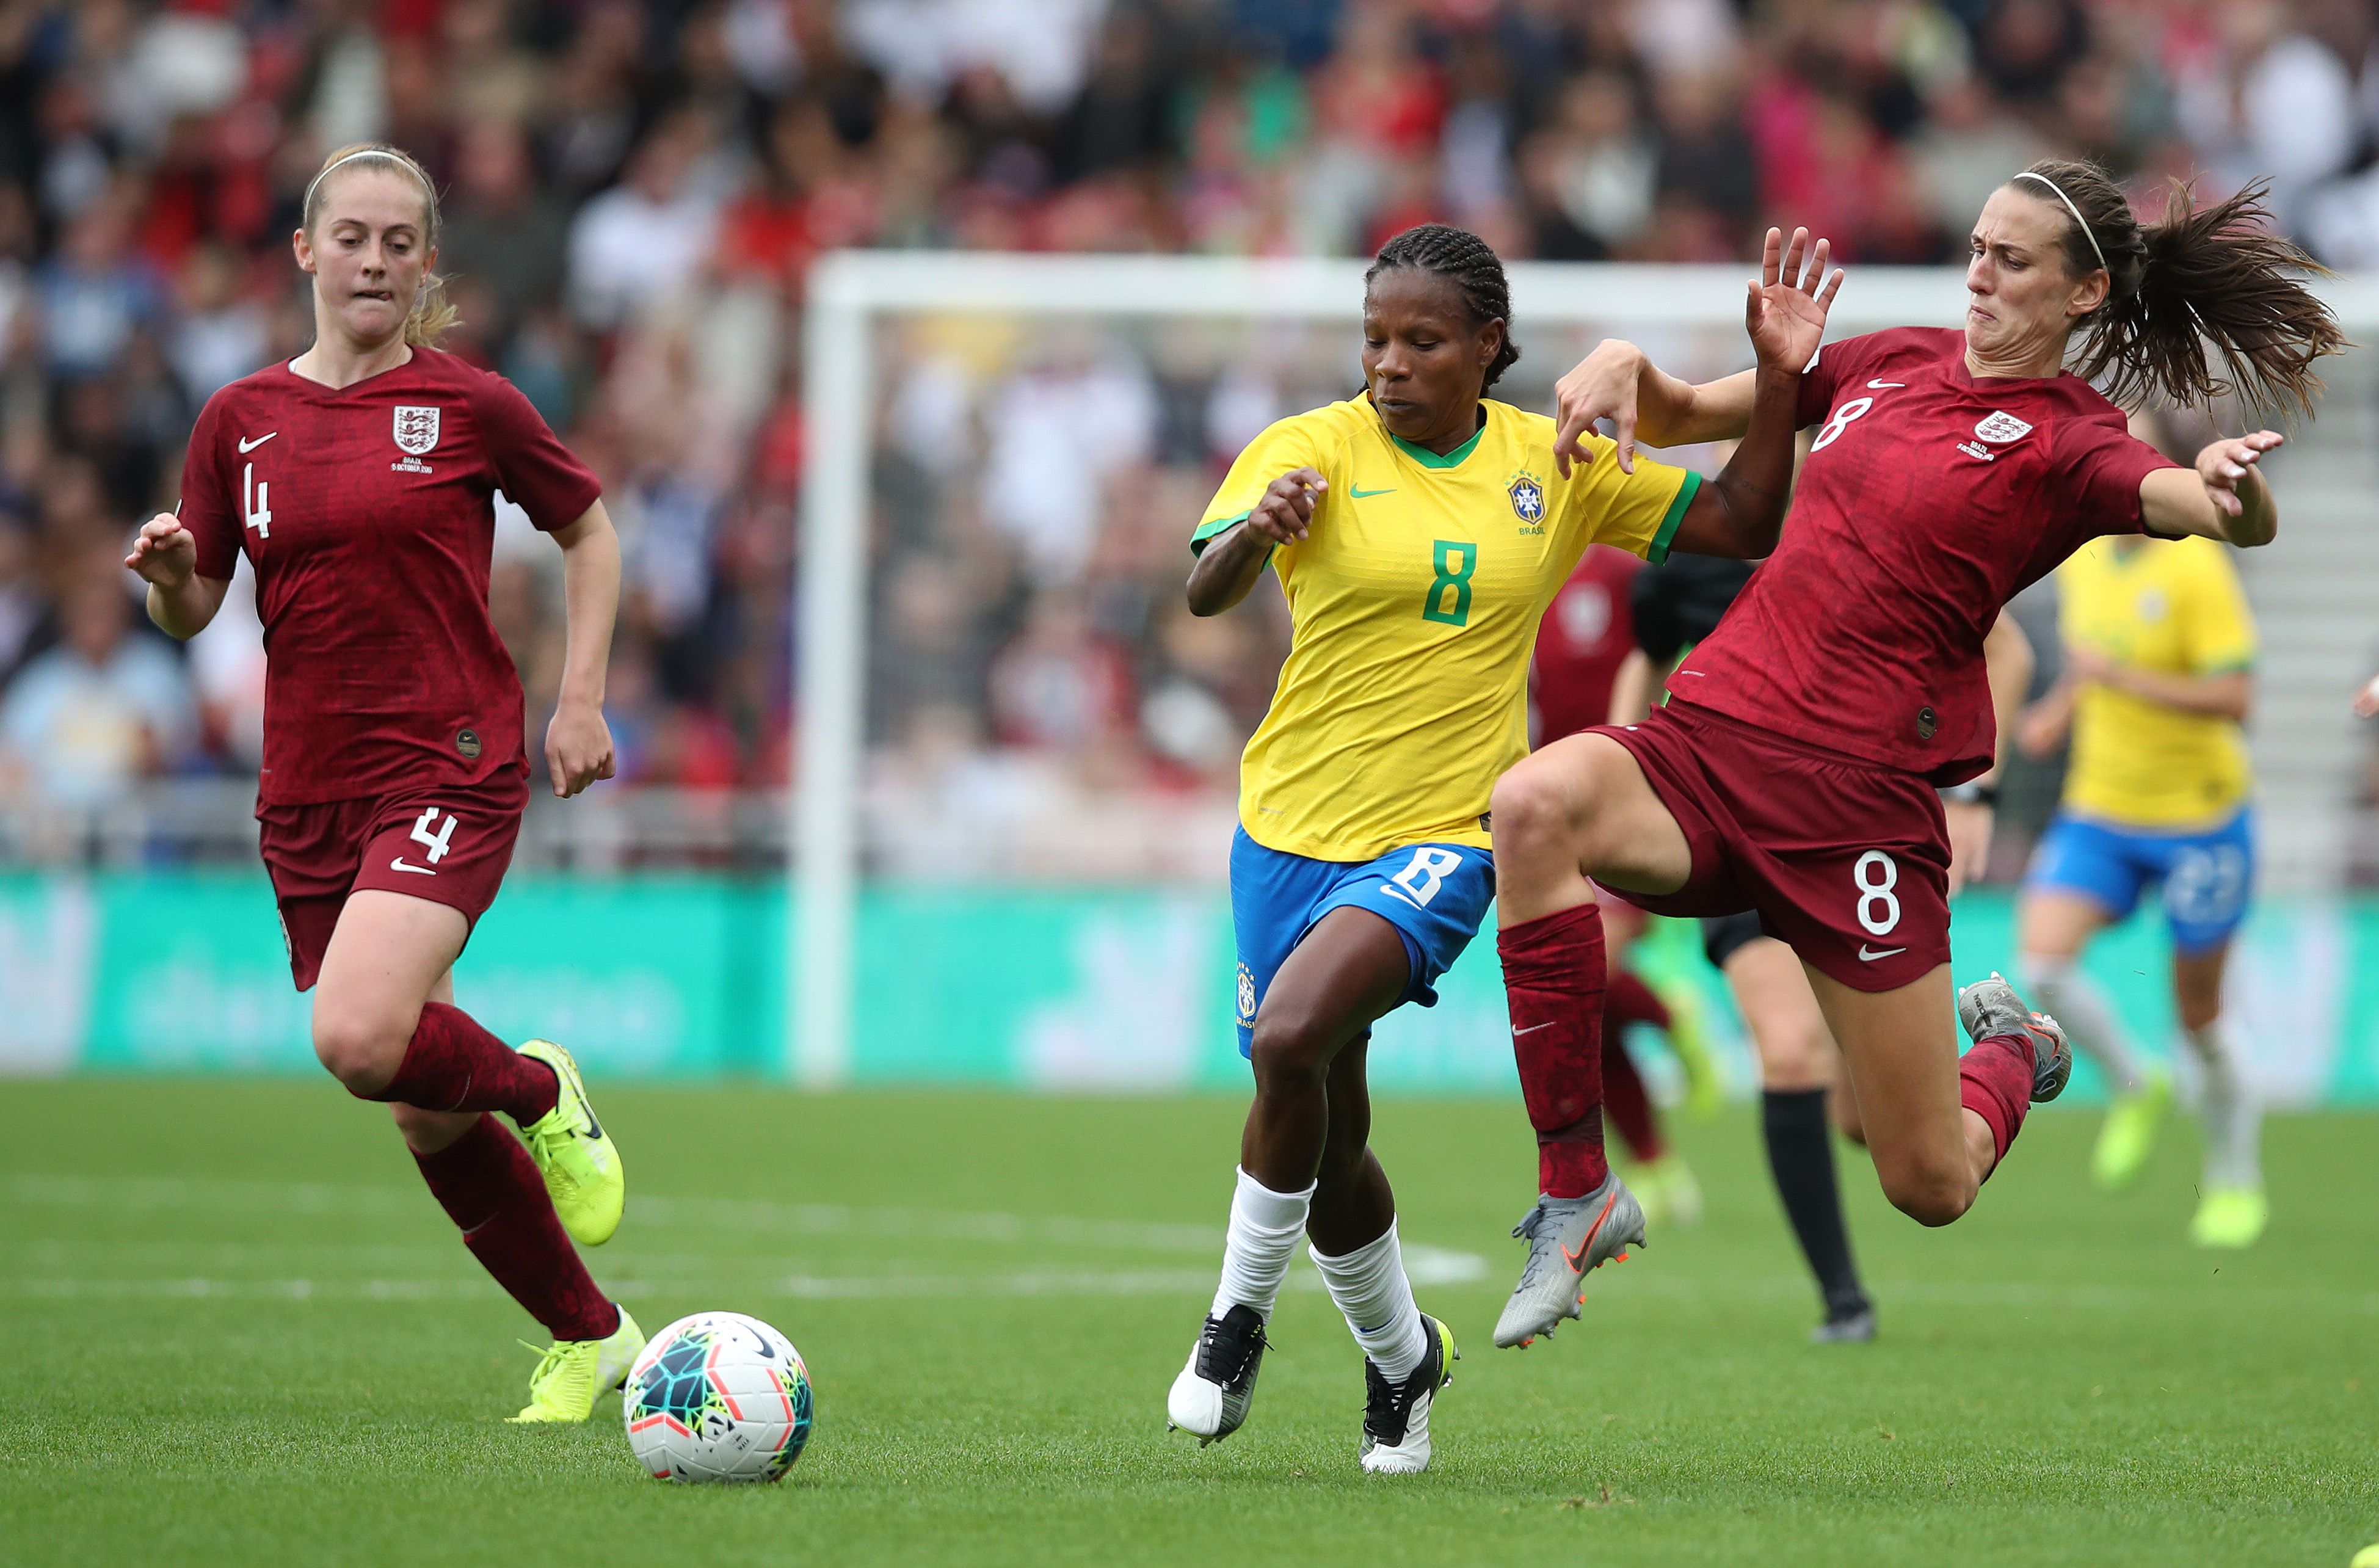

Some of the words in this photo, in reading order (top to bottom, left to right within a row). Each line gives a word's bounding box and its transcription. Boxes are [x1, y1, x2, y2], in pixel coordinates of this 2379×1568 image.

[1810, 397, 1873, 452] 8
[244, 462, 272, 539] 4
[1423, 540, 1477, 626] 8
[410, 807, 458, 865] 4
[1391, 847, 1464, 907] 8
[1854, 849, 1901, 936] 8
[1237, 1015, 1255, 1029] BRASI
